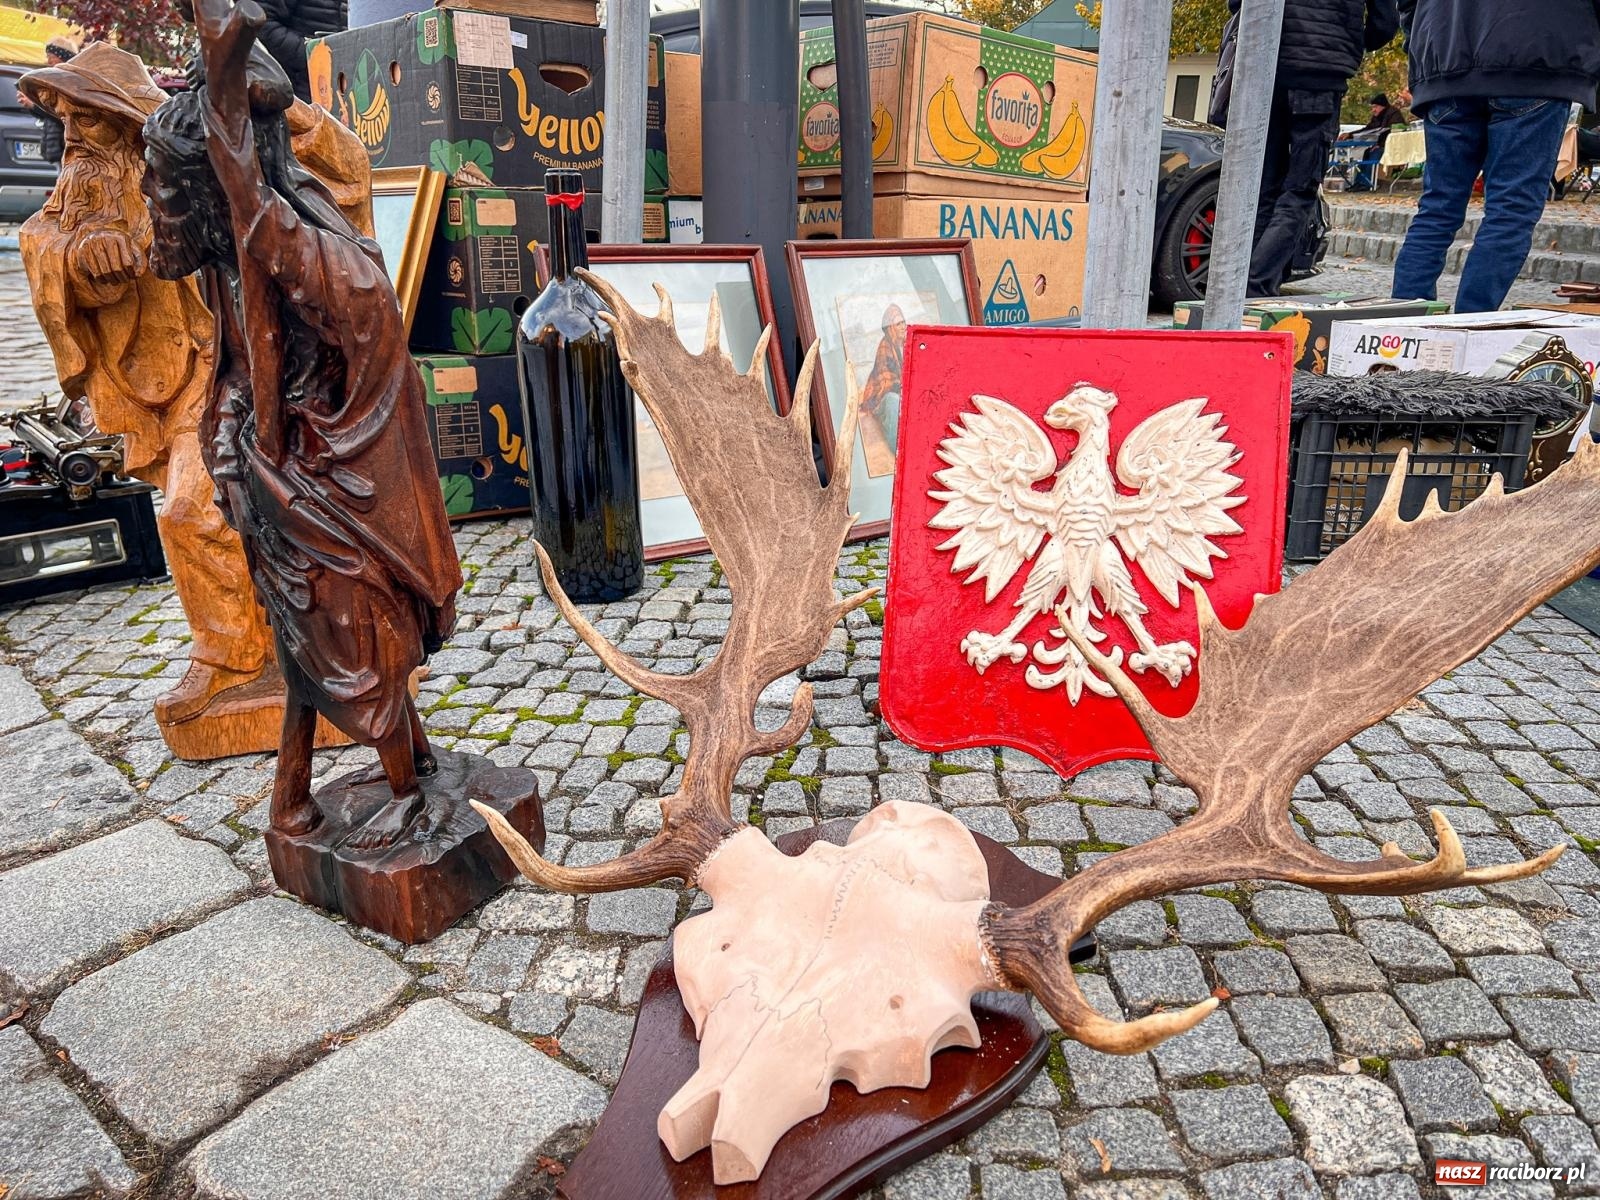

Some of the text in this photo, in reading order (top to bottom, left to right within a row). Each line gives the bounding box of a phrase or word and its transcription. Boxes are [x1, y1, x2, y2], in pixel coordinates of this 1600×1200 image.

[991, 89, 1039, 130] favorita
[806, 112, 840, 137] favorita
[533, 151, 604, 170] PREMIUM BANANA
[669, 217, 695, 229] mium
[939, 203, 1073, 241] BANANAS
[984, 308, 1026, 323] AMIGO
